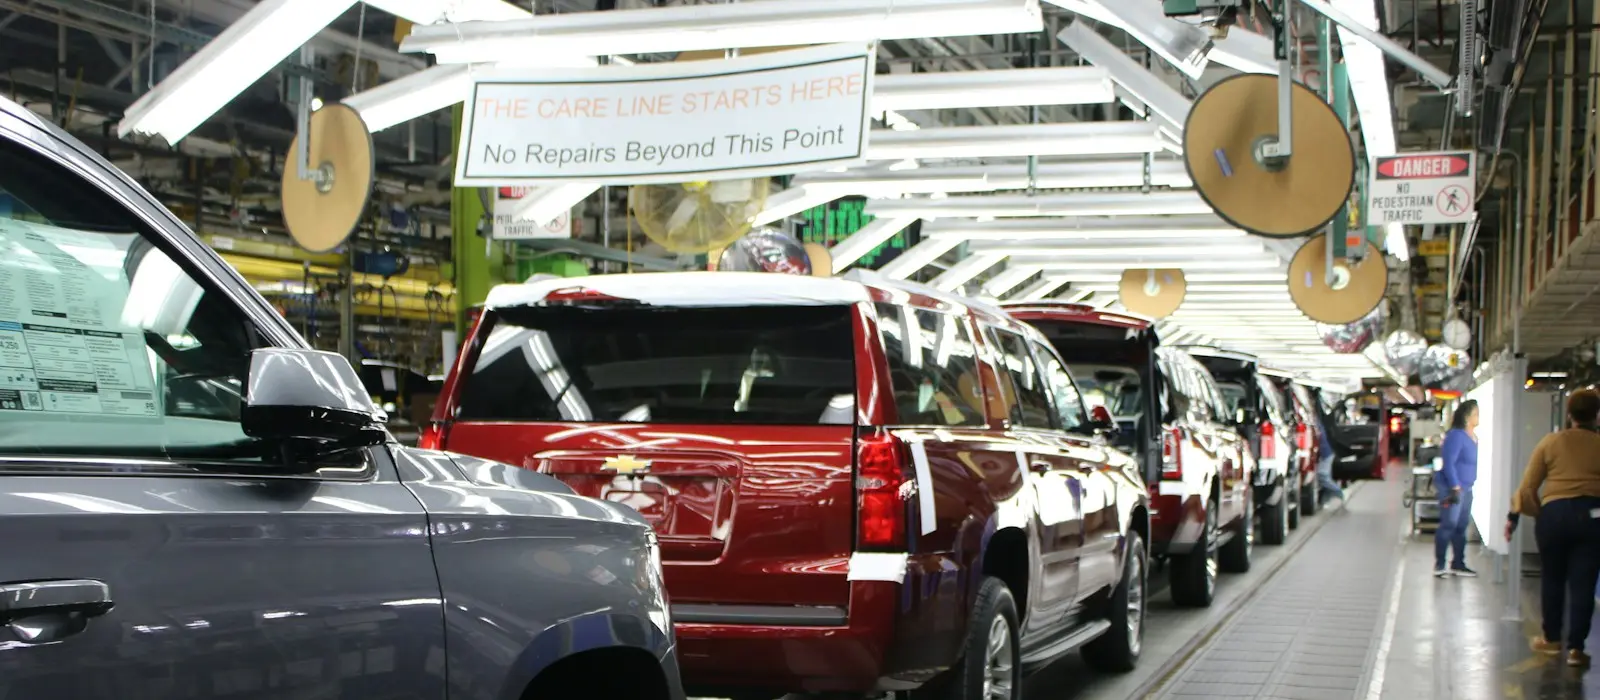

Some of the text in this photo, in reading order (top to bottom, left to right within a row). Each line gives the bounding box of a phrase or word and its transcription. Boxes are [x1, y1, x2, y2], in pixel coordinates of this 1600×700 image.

[480, 73, 862, 119] THE CARE LINE STARTS HERE
[483, 124, 845, 168] No Repairs Beyond This Point
[1393, 158, 1451, 177] DANGER
[1396, 183, 1410, 194] NO
[1372, 196, 1433, 208] PEDESTRIAN
[1383, 210, 1422, 221] TRAFFIC
[504, 225, 533, 236] TRAFFIC
